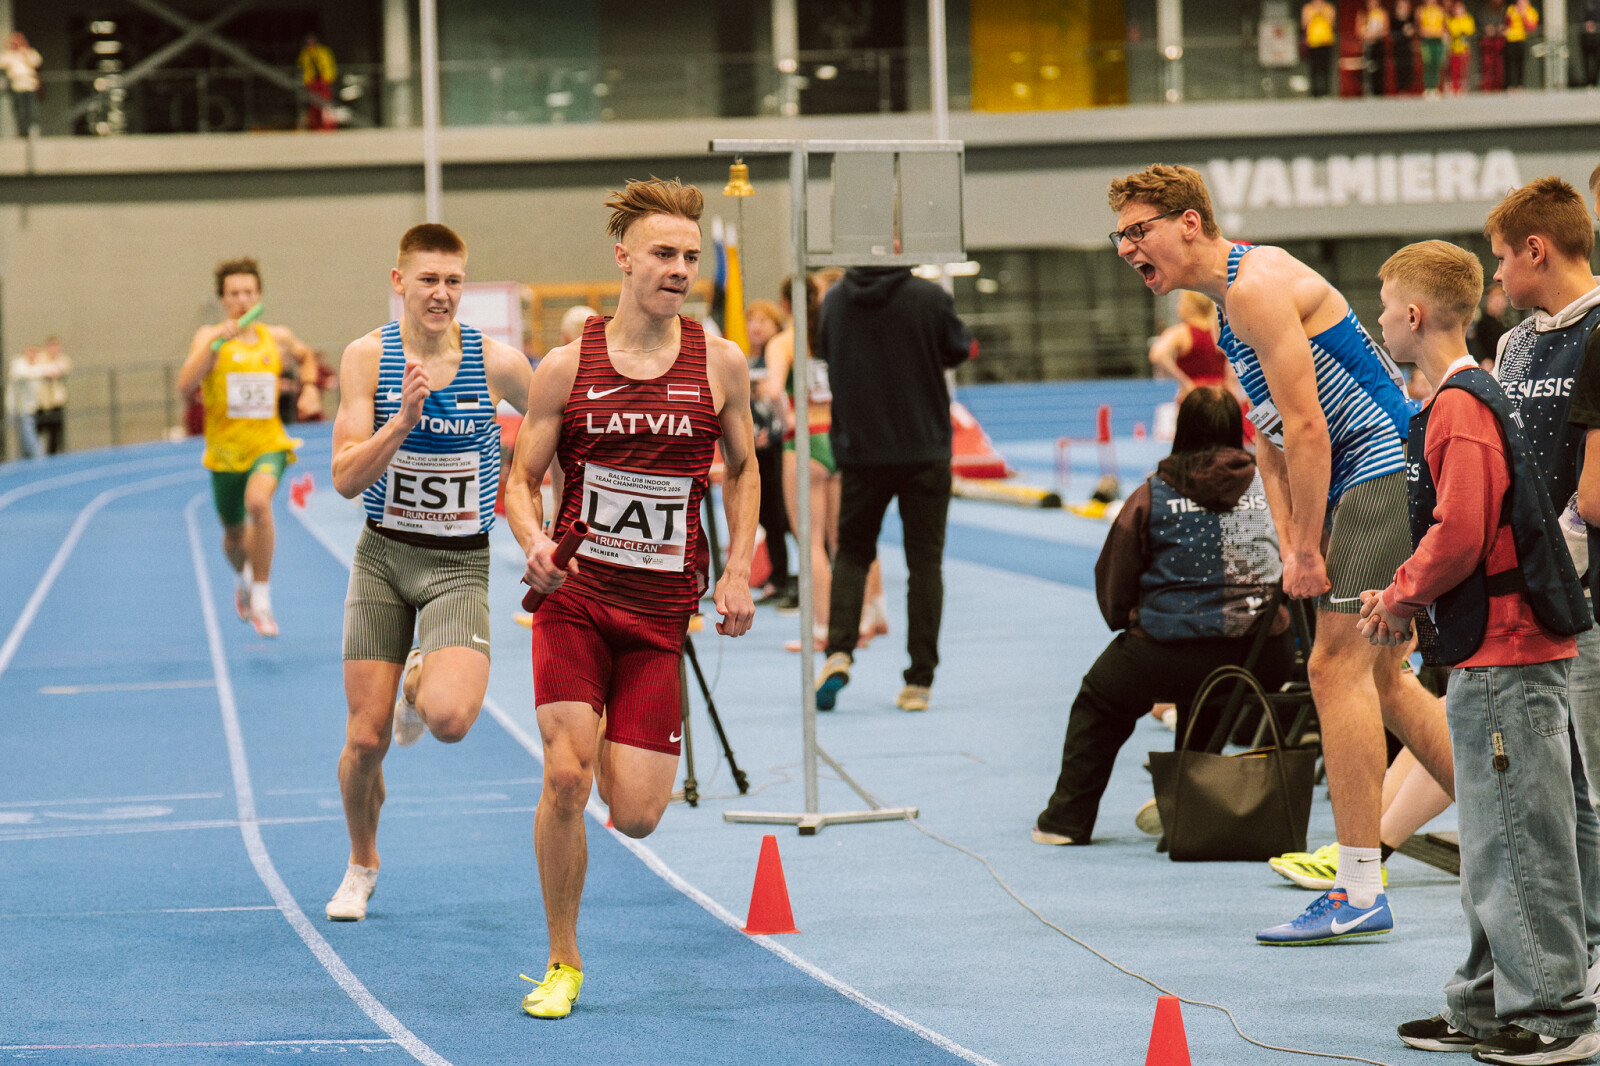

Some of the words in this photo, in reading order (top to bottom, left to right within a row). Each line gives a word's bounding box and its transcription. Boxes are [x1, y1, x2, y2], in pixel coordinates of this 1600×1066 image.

[1207, 150, 1522, 209] VALMIERA
[388, 413, 476, 435] TONIA
[586, 412, 694, 437] LATVIA
[396, 458, 411, 466] TEAM
[595, 474, 612, 484] TEAM
[612, 480, 667, 492] CHAMPIONSHIPS
[608, 472, 631, 482] BALTIC
[392, 472, 475, 508] EST
[1166, 494, 1267, 514] TIESIS
[406, 510, 425, 520] RUN
[426, 512, 457, 520] CLEAN
[586, 490, 684, 541] LAT
[396, 521, 422, 529] VALMIERA
[589, 546, 619, 558] VALMIERA
[595, 536, 599, 544] I
[600, 536, 622, 548] RUN
[623, 539, 658, 553] CLEAN
